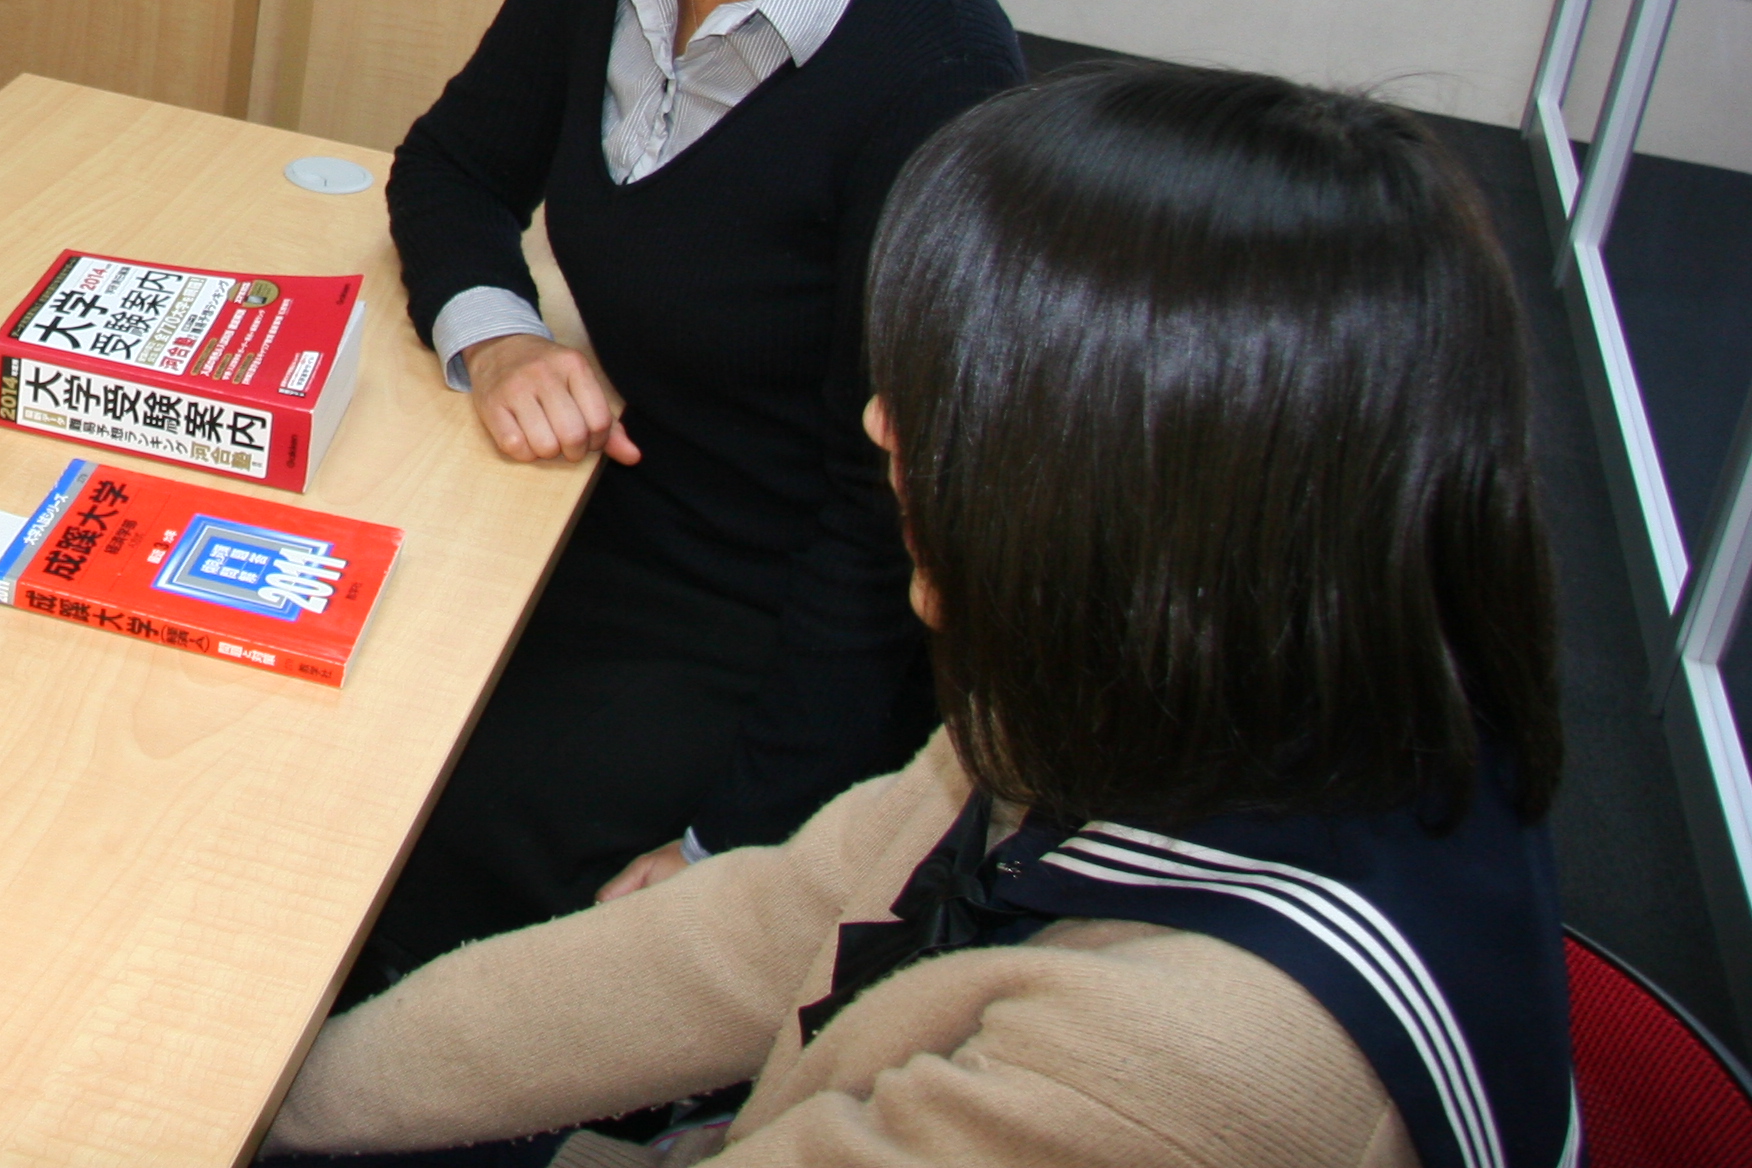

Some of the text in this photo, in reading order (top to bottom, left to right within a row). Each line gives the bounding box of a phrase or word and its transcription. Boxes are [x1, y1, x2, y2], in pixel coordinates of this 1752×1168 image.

[34, 291, 108, 350] 大学
[89, 270, 183, 360] 受験案内
[159, 337, 194, 370] 河合塾
[0, 375, 18, 421] 2014
[25, 366, 267, 451] 大学受験案内
[69, 421, 189, 454] 難易予想ランキング
[190, 442, 253, 470] 河合塾
[24, 493, 69, 545] 大学入試シリーズ
[104, 519, 138, 555] 経済学部
[258, 546, 349, 614] 2011
